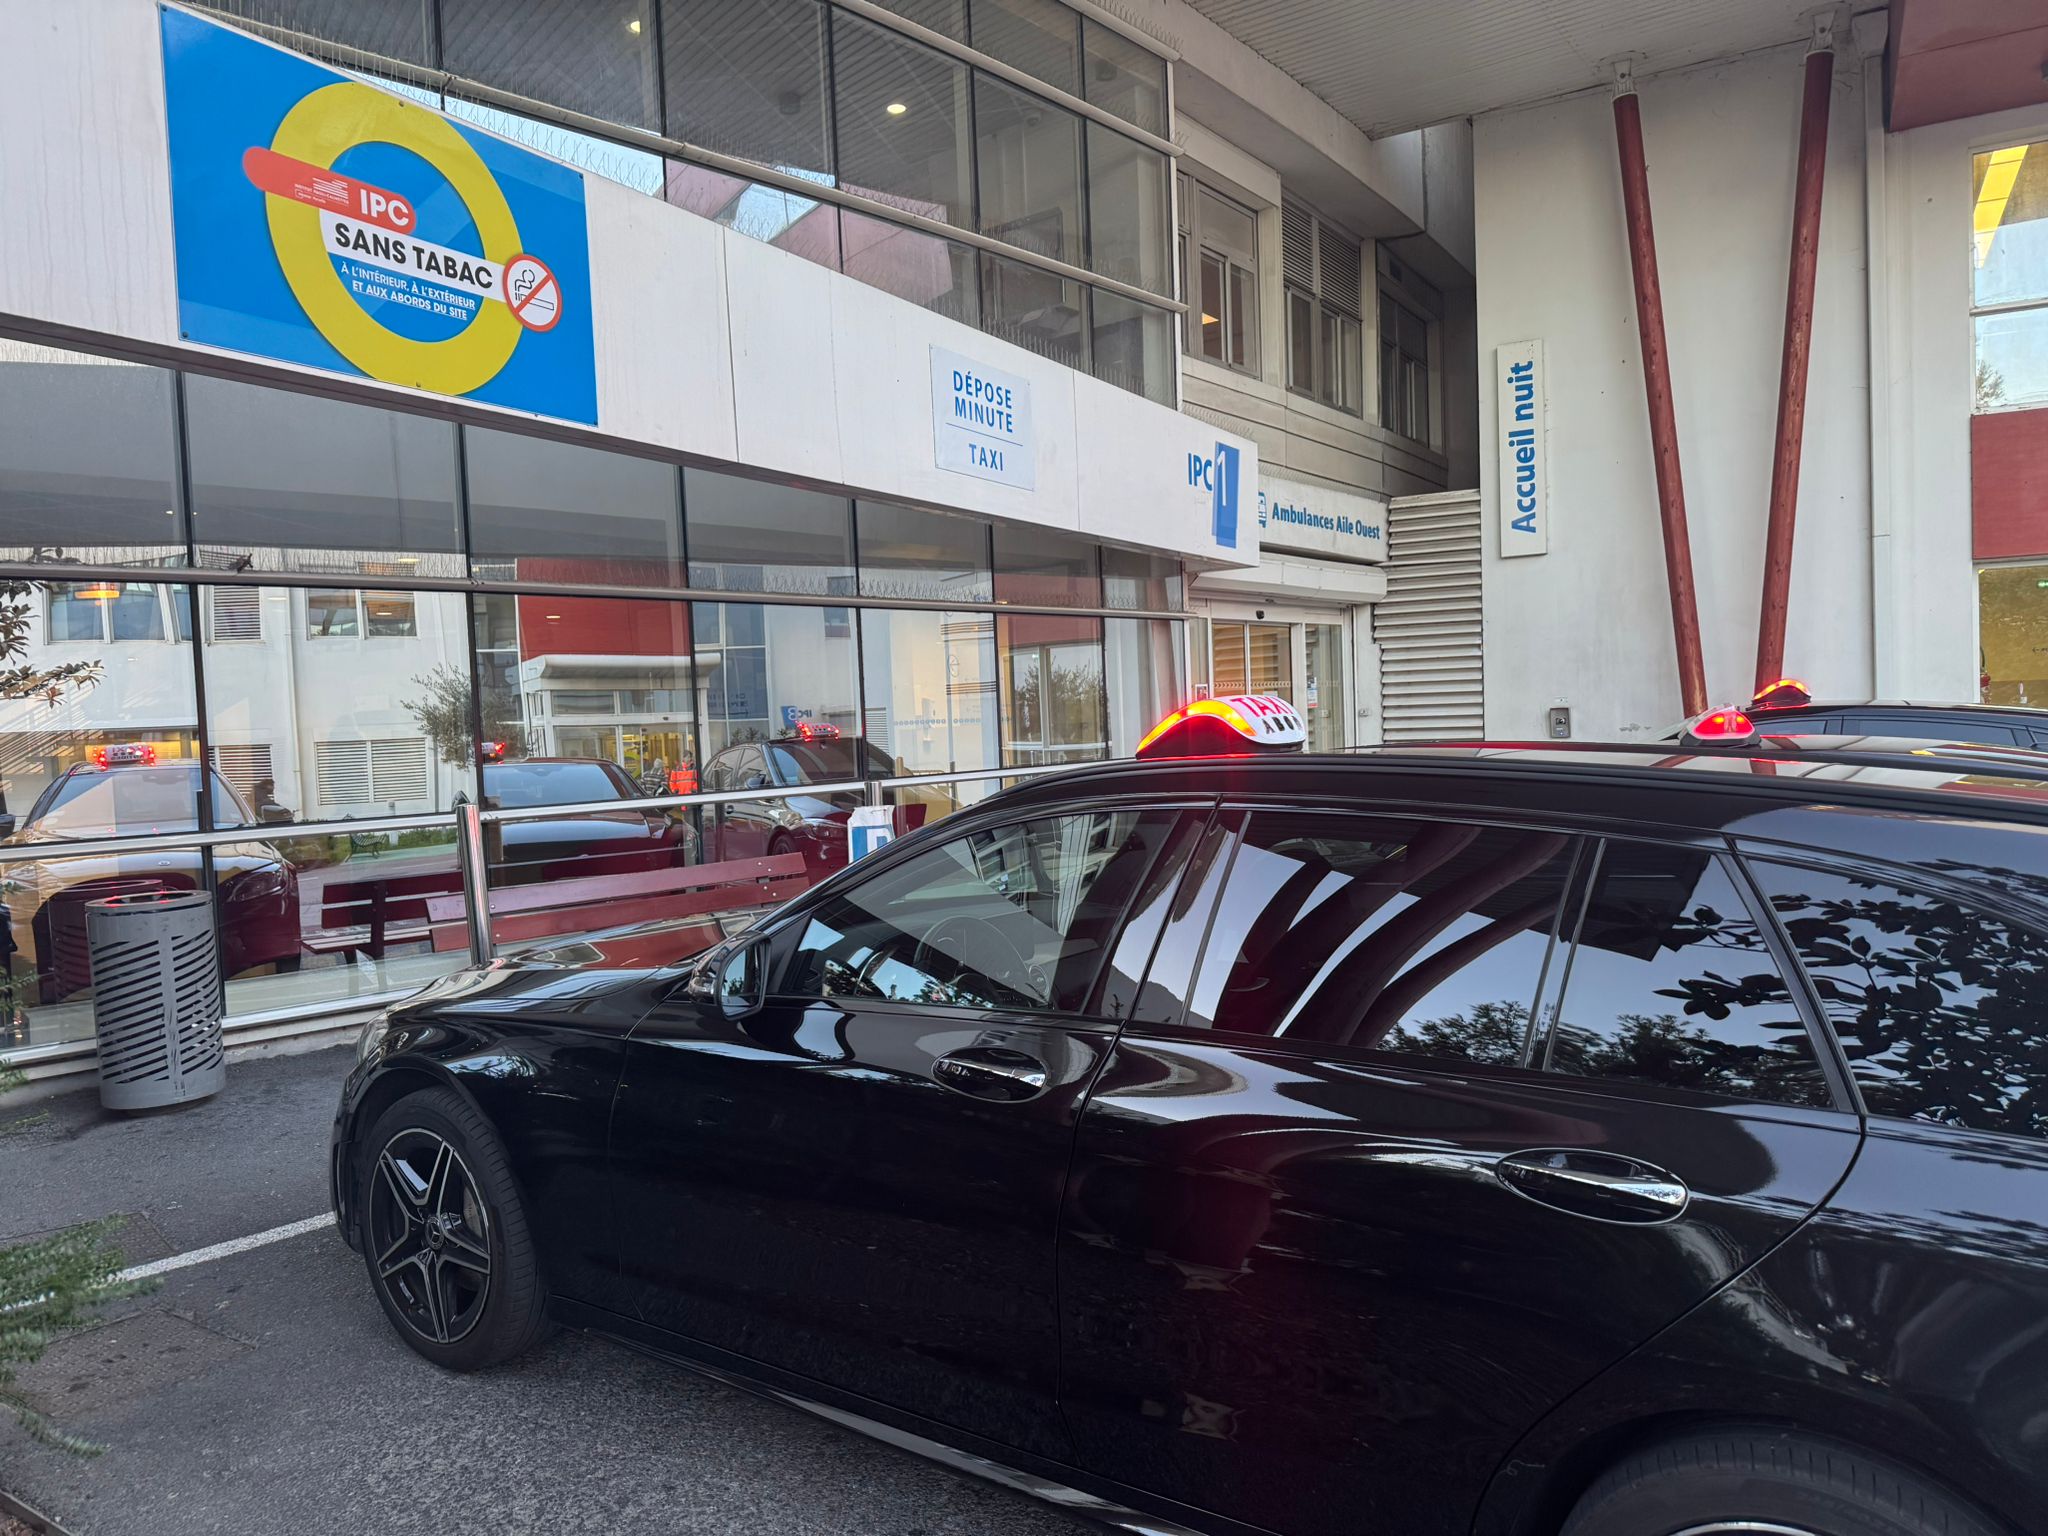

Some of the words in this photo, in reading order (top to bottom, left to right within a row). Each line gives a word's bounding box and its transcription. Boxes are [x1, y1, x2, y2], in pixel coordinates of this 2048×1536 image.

[360, 188, 410, 227] IPC
[335, 223, 407, 265] SANS
[412, 246, 493, 290] TABAC
[341, 261, 349, 274] À
[411, 281, 419, 294] À
[421, 286, 476, 310] L'EXTÉRIEUR
[353, 280, 364, 291] ET
[366, 285, 388, 299] AUX
[390, 292, 431, 311] ABORDS
[433, 302, 447, 314] DU
[449, 306, 468, 320] SITE
[953, 370, 1012, 409] DÉPOSE
[1507, 361, 1535, 421] nuit
[955, 396, 1013, 433] MINUTE
[969, 443, 1003, 471] TAXI
[1187, 453, 1213, 491] IPC
[1216, 450, 1227, 507] 1
[1508, 428, 1537, 533] Accueil
[1272, 502, 1334, 531] Ambulances
[1336, 515, 1354, 535] Aile
[1355, 519, 1381, 540] Ouest
[1230, 696, 1293, 717] TAXI
